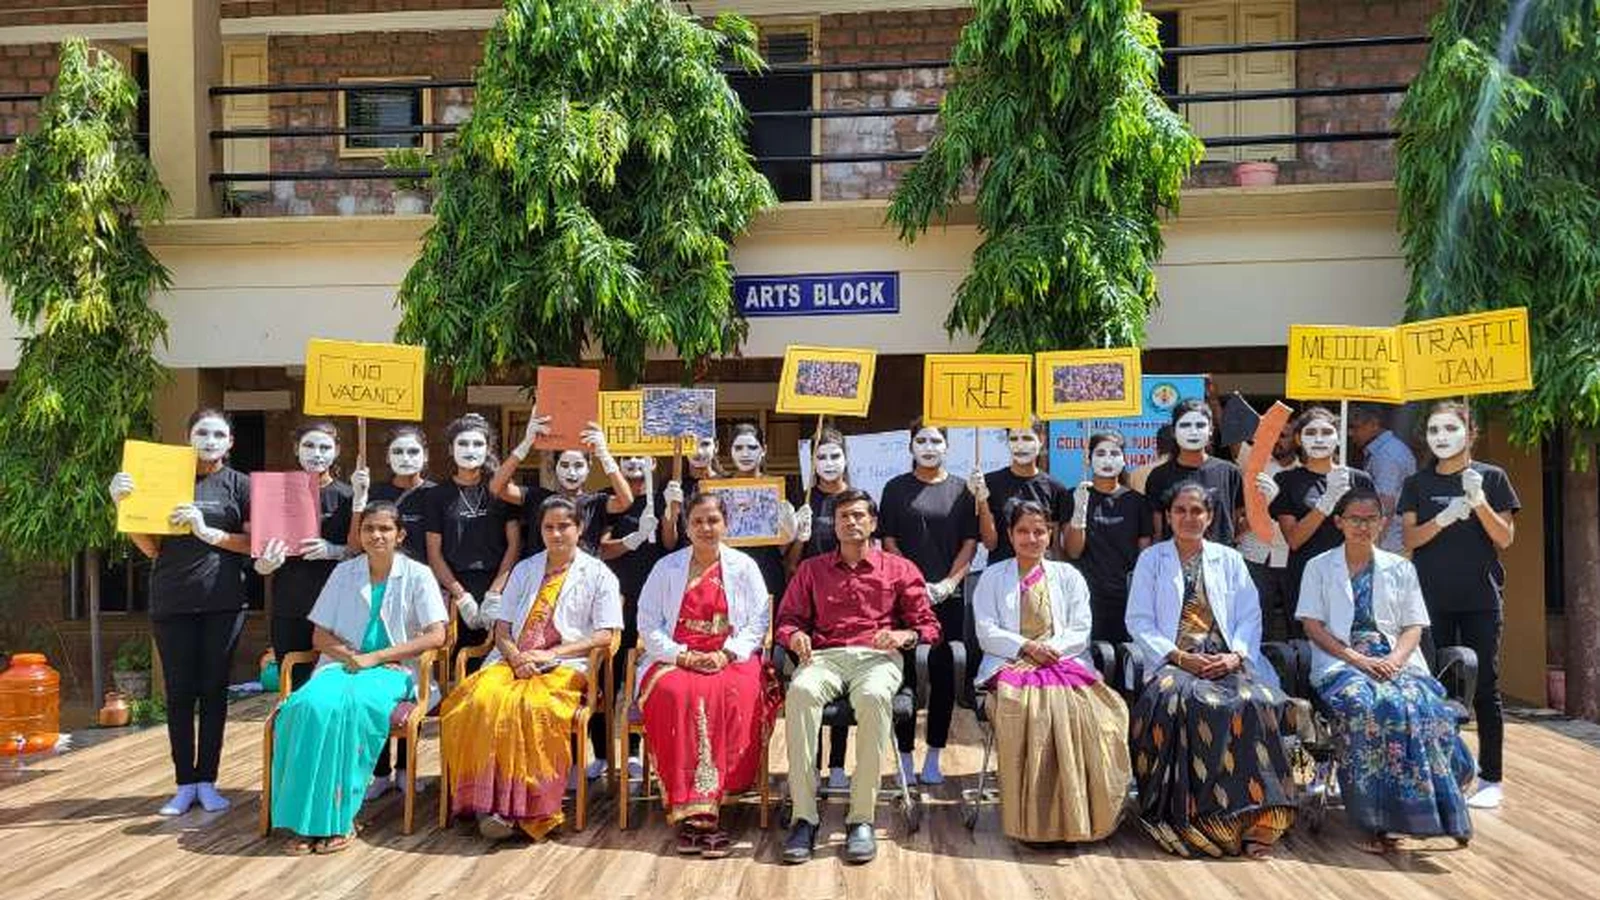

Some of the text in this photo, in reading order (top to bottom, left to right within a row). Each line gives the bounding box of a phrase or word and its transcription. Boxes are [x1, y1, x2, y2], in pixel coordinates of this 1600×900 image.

[744, 281, 886, 308] ARTS BLOCK
[1301, 335, 1398, 363] MEDICAL
[1406, 318, 1520, 356] TRAFFIC
[352, 363, 382, 381] NO
[1308, 365, 1390, 391] STORE
[1434, 356, 1494, 385] JAM
[328, 383, 409, 406] VACANCY
[942, 372, 1015, 409] TREE
